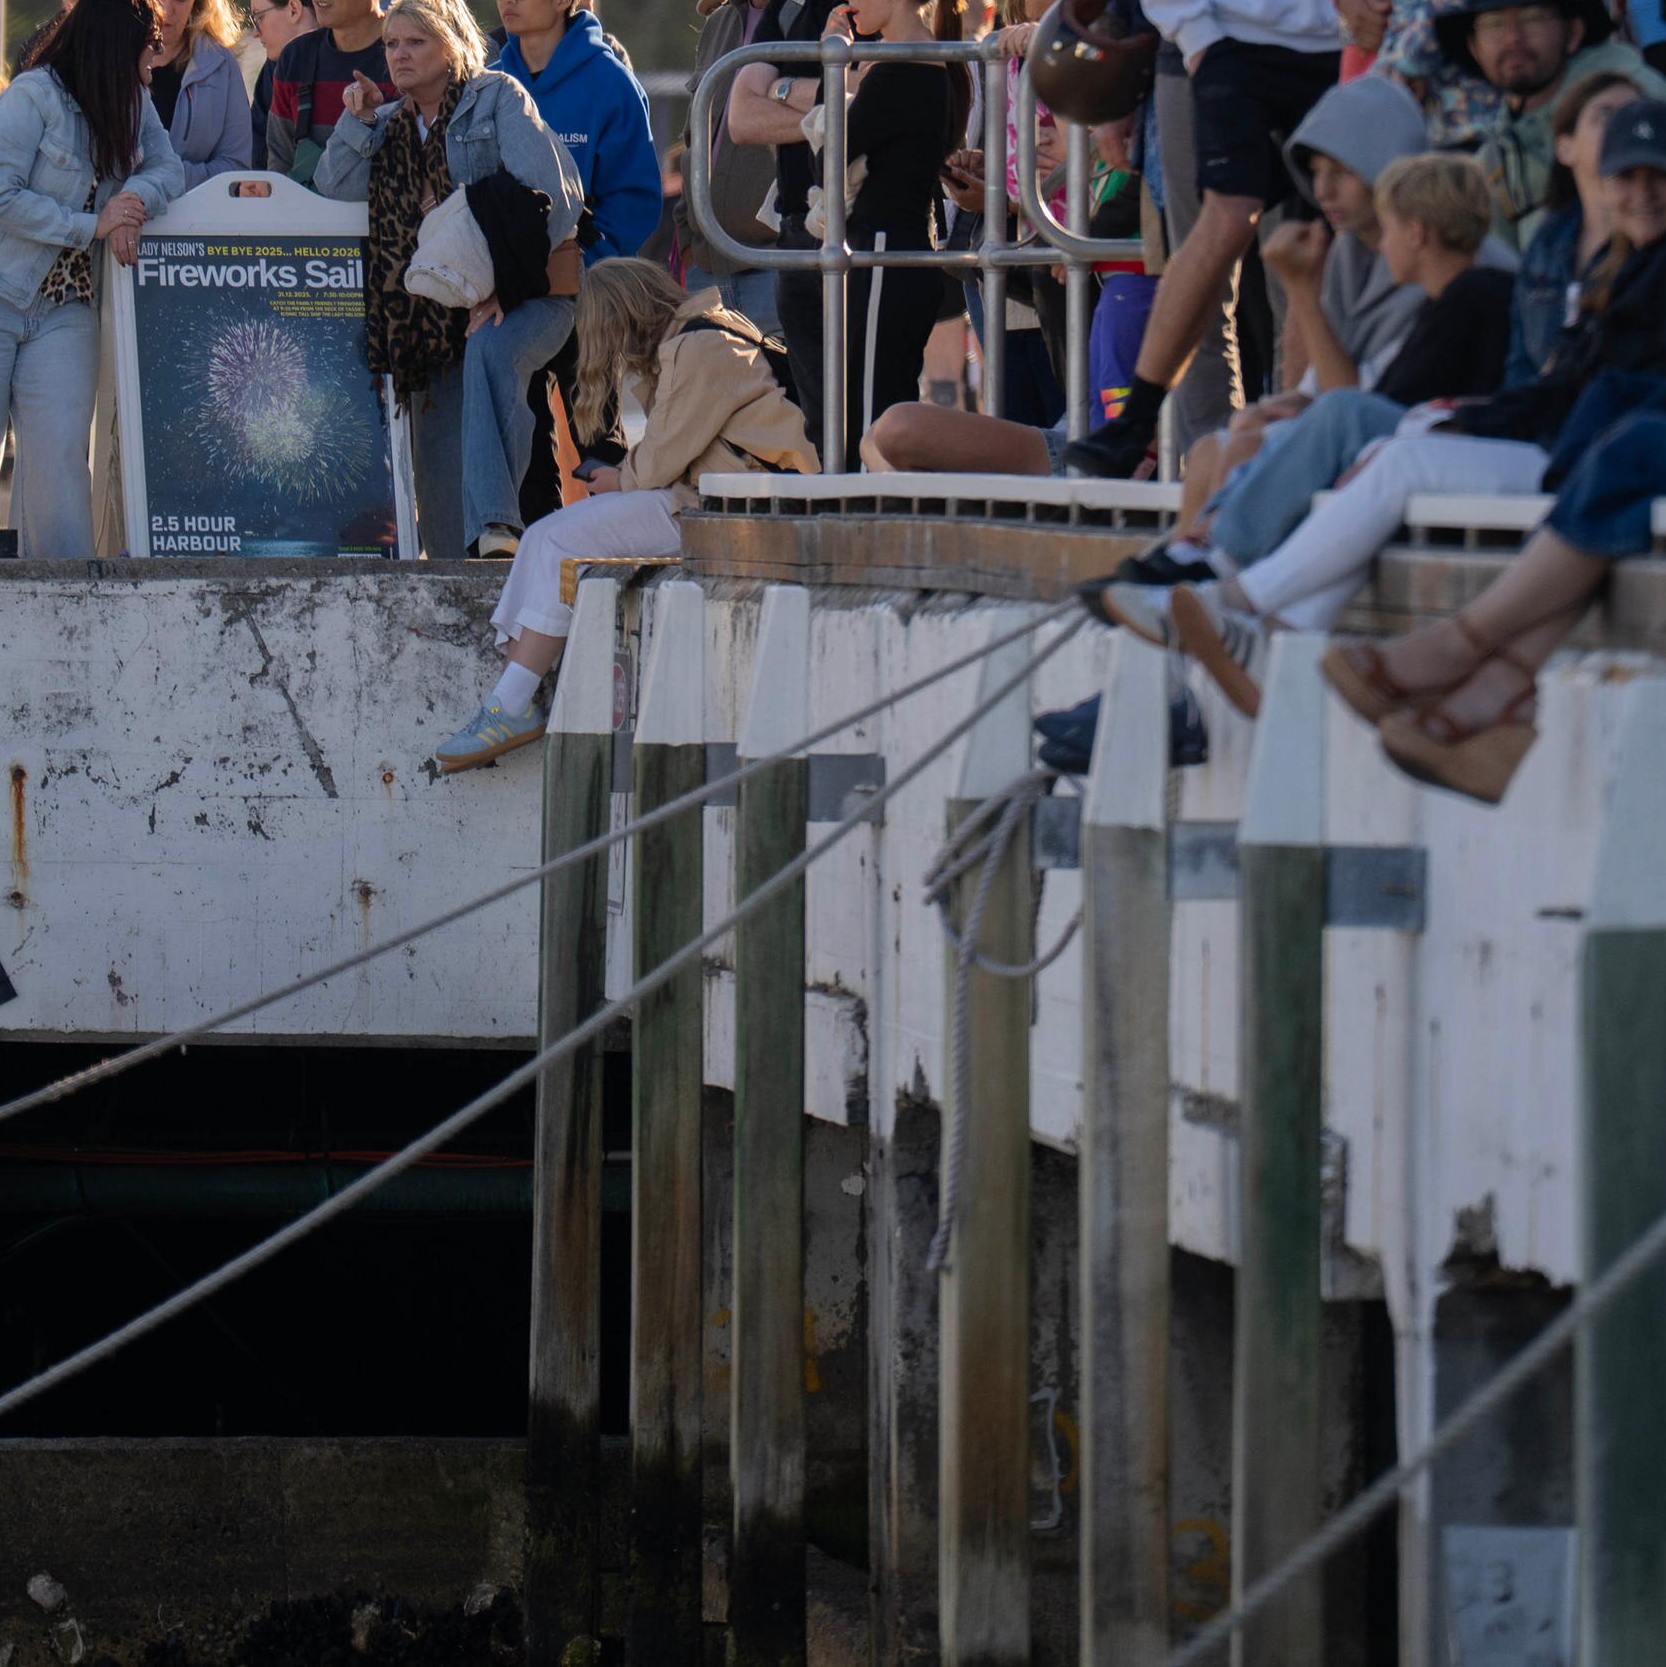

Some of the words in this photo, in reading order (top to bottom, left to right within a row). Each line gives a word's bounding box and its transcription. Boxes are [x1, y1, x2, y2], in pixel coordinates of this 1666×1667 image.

[137, 242, 159, 256] LADY
[161, 242, 205, 257] NELSON'S
[207, 246, 230, 256] BYE
[231, 246, 253, 256] BYE
[255, 246, 292, 257] 2025...
[294, 247, 330, 257] HELLO
[332, 247, 361, 257] 2026
[137, 258, 298, 288] Fireworks
[305, 259, 364, 289] Sail
[152, 516, 179, 532] 2.5
[184, 516, 236, 532] HOUR
[153, 535, 242, 551] HARBOUR
